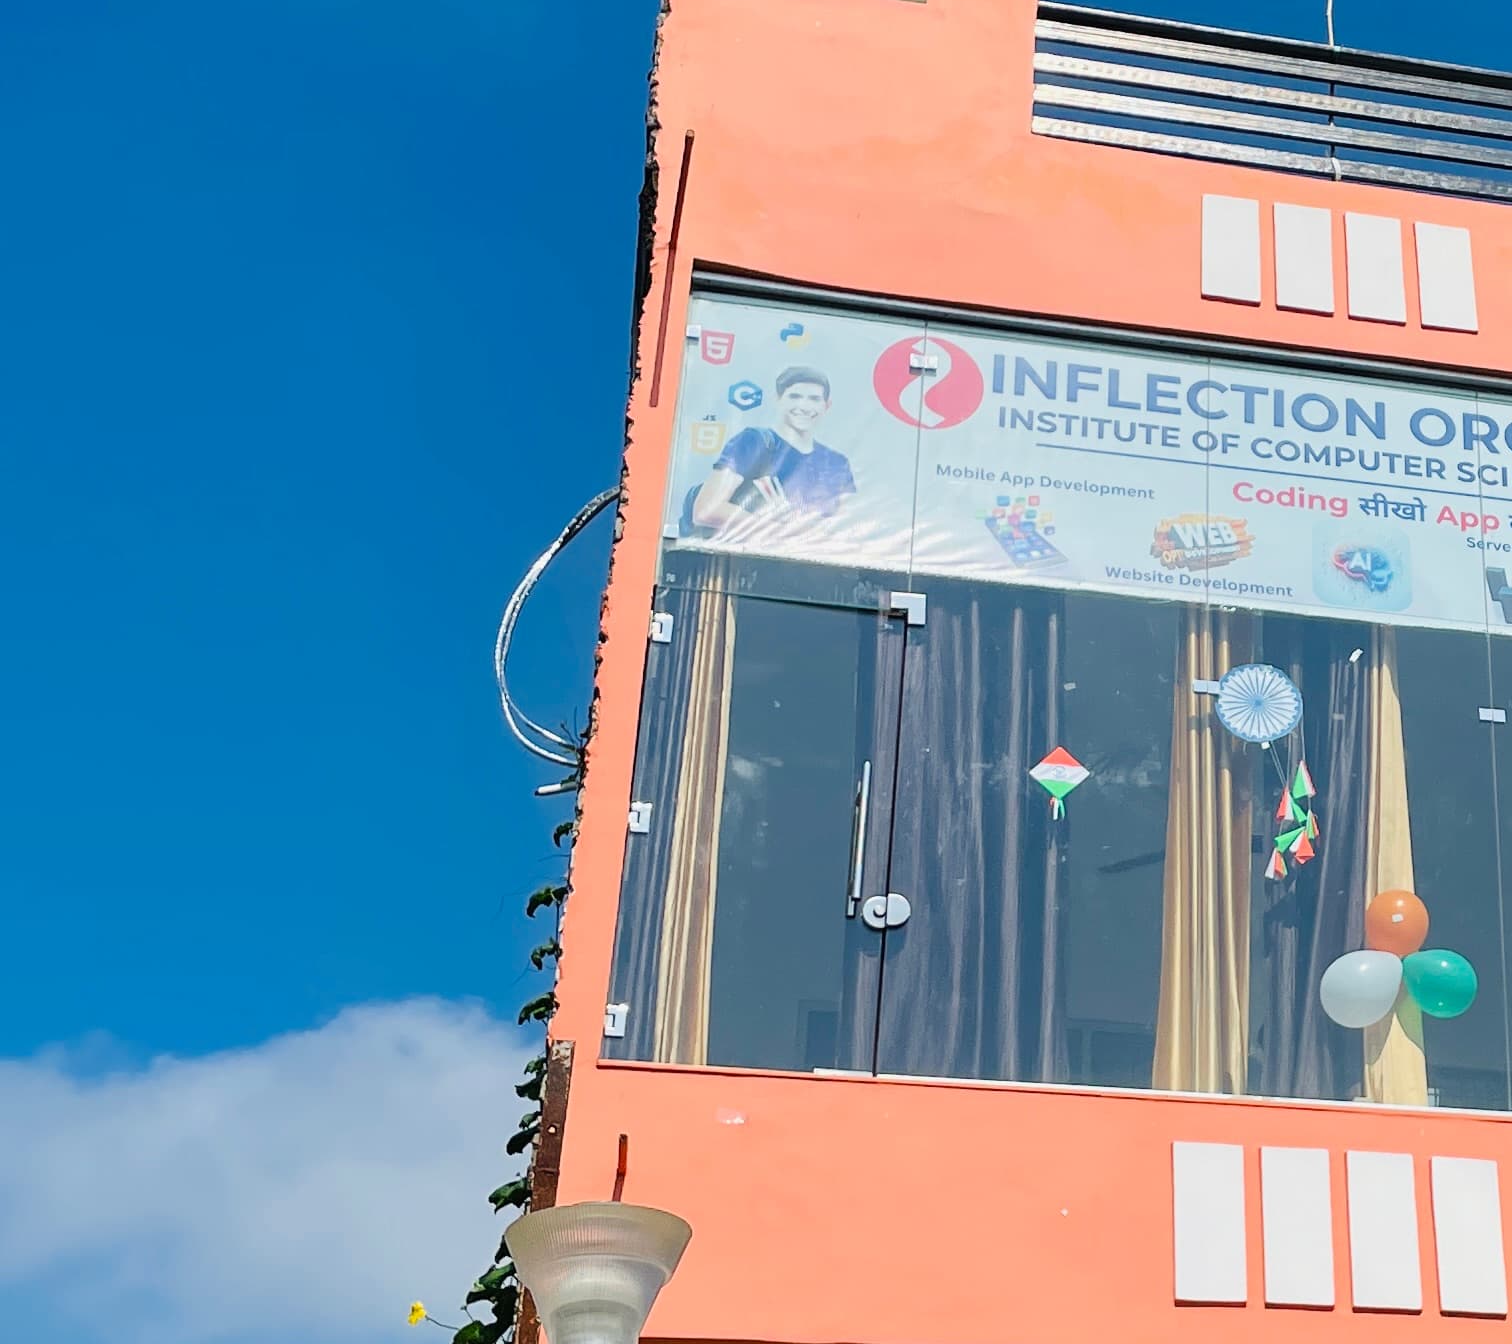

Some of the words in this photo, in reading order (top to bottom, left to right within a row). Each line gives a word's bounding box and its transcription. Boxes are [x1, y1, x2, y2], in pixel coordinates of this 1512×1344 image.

[992, 354, 1386, 440] INFLECTION
[998, 406, 1181, 448] INSTITUTE
[1192, 430, 1240, 454] OF
[1250, 437, 1446, 480] COMPUTER
[936, 463, 996, 482] Mobile
[1000, 471, 1035, 488] App
[1039, 475, 1156, 500] Development
[1232, 482, 1349, 518] Coding
[1358, 492, 1427, 522] सीखो
[1436, 505, 1500, 534] App
[1172, 522, 1238, 549] WEB
[1350, 552, 1371, 572] AI
[1105, 566, 1174, 584] Website
[1179, 574, 1294, 597] Development
